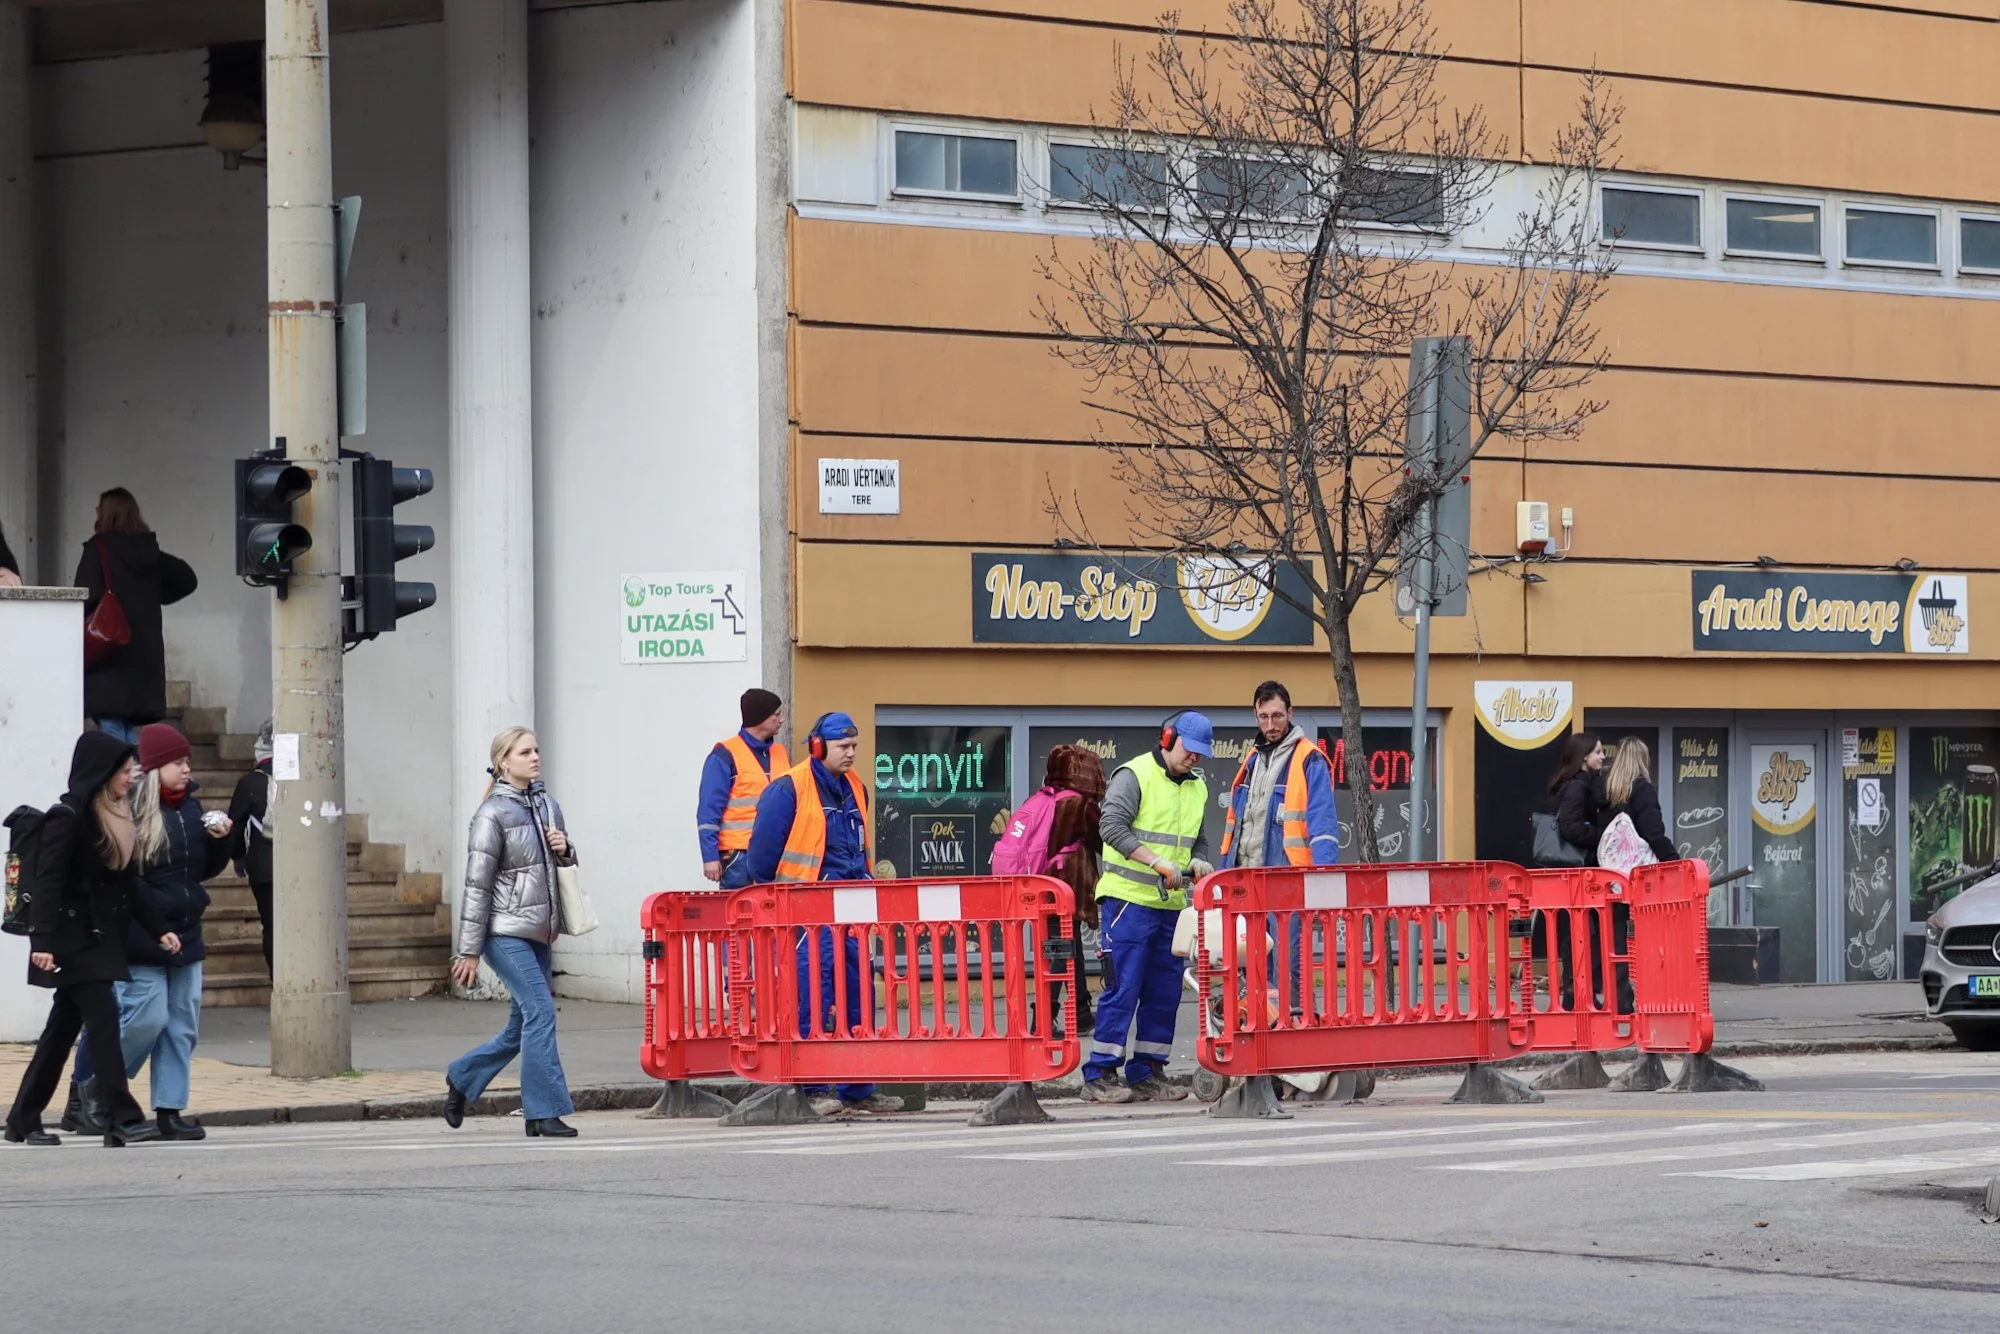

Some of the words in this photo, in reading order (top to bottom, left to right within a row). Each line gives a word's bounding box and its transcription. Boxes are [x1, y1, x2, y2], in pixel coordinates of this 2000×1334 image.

[824, 467, 850, 488] ARADI
[853, 465, 896, 488] VÉRTANÚK
[851, 495, 872, 505] TERE
[648, 583, 673, 598] Top
[675, 582, 715, 596] Tours
[985, 564, 1158, 637] Non-Stop
[627, 608, 715, 634] UTAZÁSI
[1698, 583, 1783, 636] Aradi
[1786, 585, 1900, 646] Csemege
[638, 638, 705, 659] IRODA
[1492, 686, 1558, 727] Akció
[1706, 738, 1718, 757] és
[1317, 738, 1411, 791] Mgn
[1769, 751, 1811, 782] Non-
[1758, 772, 1798, 811] Stop
[920, 840, 965, 864] SNACK
[1763, 843, 1804, 866] Bejárat
